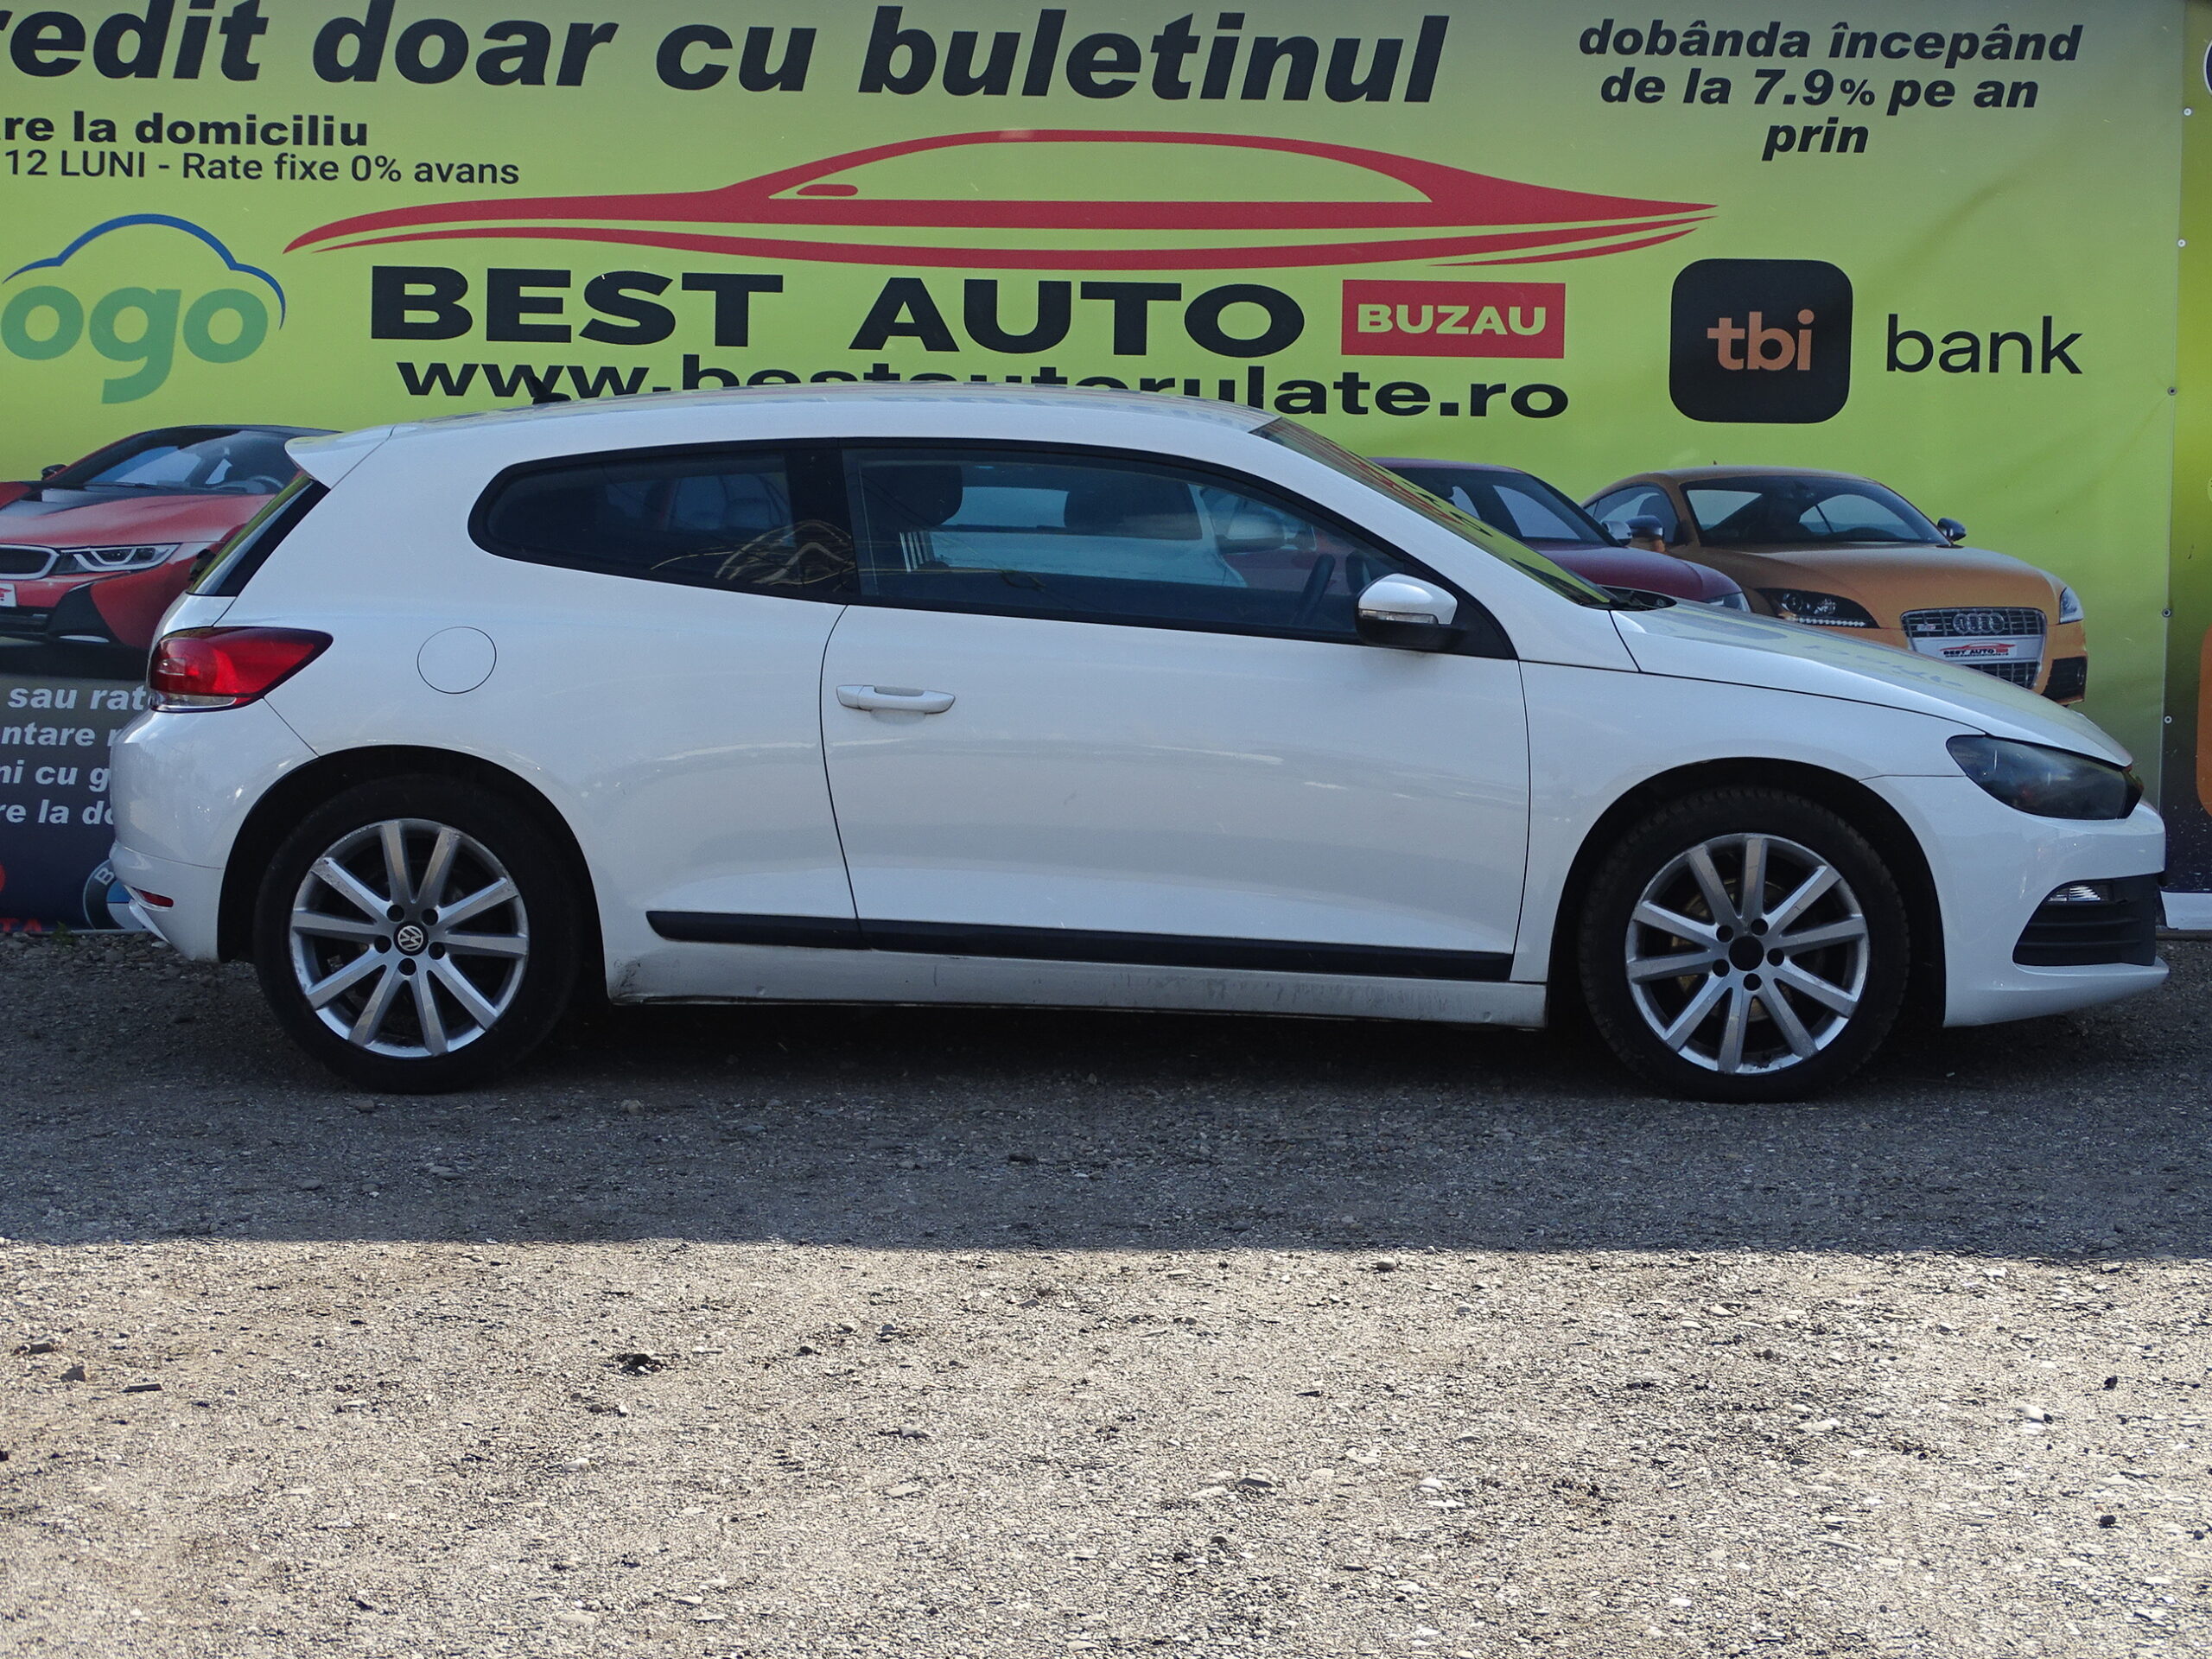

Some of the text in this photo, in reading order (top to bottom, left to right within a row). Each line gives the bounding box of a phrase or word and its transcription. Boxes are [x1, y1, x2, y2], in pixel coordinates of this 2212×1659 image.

[0, 0, 1451, 103] edit doar cu buletinul
[1579, 18, 2084, 69] dobânda începând
[1601, 67, 1667, 105] de
[1683, 68, 1732, 105] la
[1887, 76, 1956, 116] pe
[1974, 81, 2039, 109] an
[5, 111, 368, 147] re la domiciliu
[1762, 118, 1870, 162] prin
[6, 149, 48, 177] 12
[61, 150, 146, 178] LUNI
[183, 153, 264, 181] Rate
[275, 153, 340, 181] fixe
[352, 156, 403, 183] 0%
[415, 162, 520, 185] avans
[372, 265, 1548, 359] BEST AUTO BUZAU
[1, 285, 269, 404] ogo
[1707, 309, 2083, 375] tbi bank
[397, 353, 1569, 418] wwwbulate.ro
[8, 685, 151, 710] sau rat
[2, 722, 96, 747] ntare
[35, 766, 79, 785] cu
[38, 799, 70, 824] la
